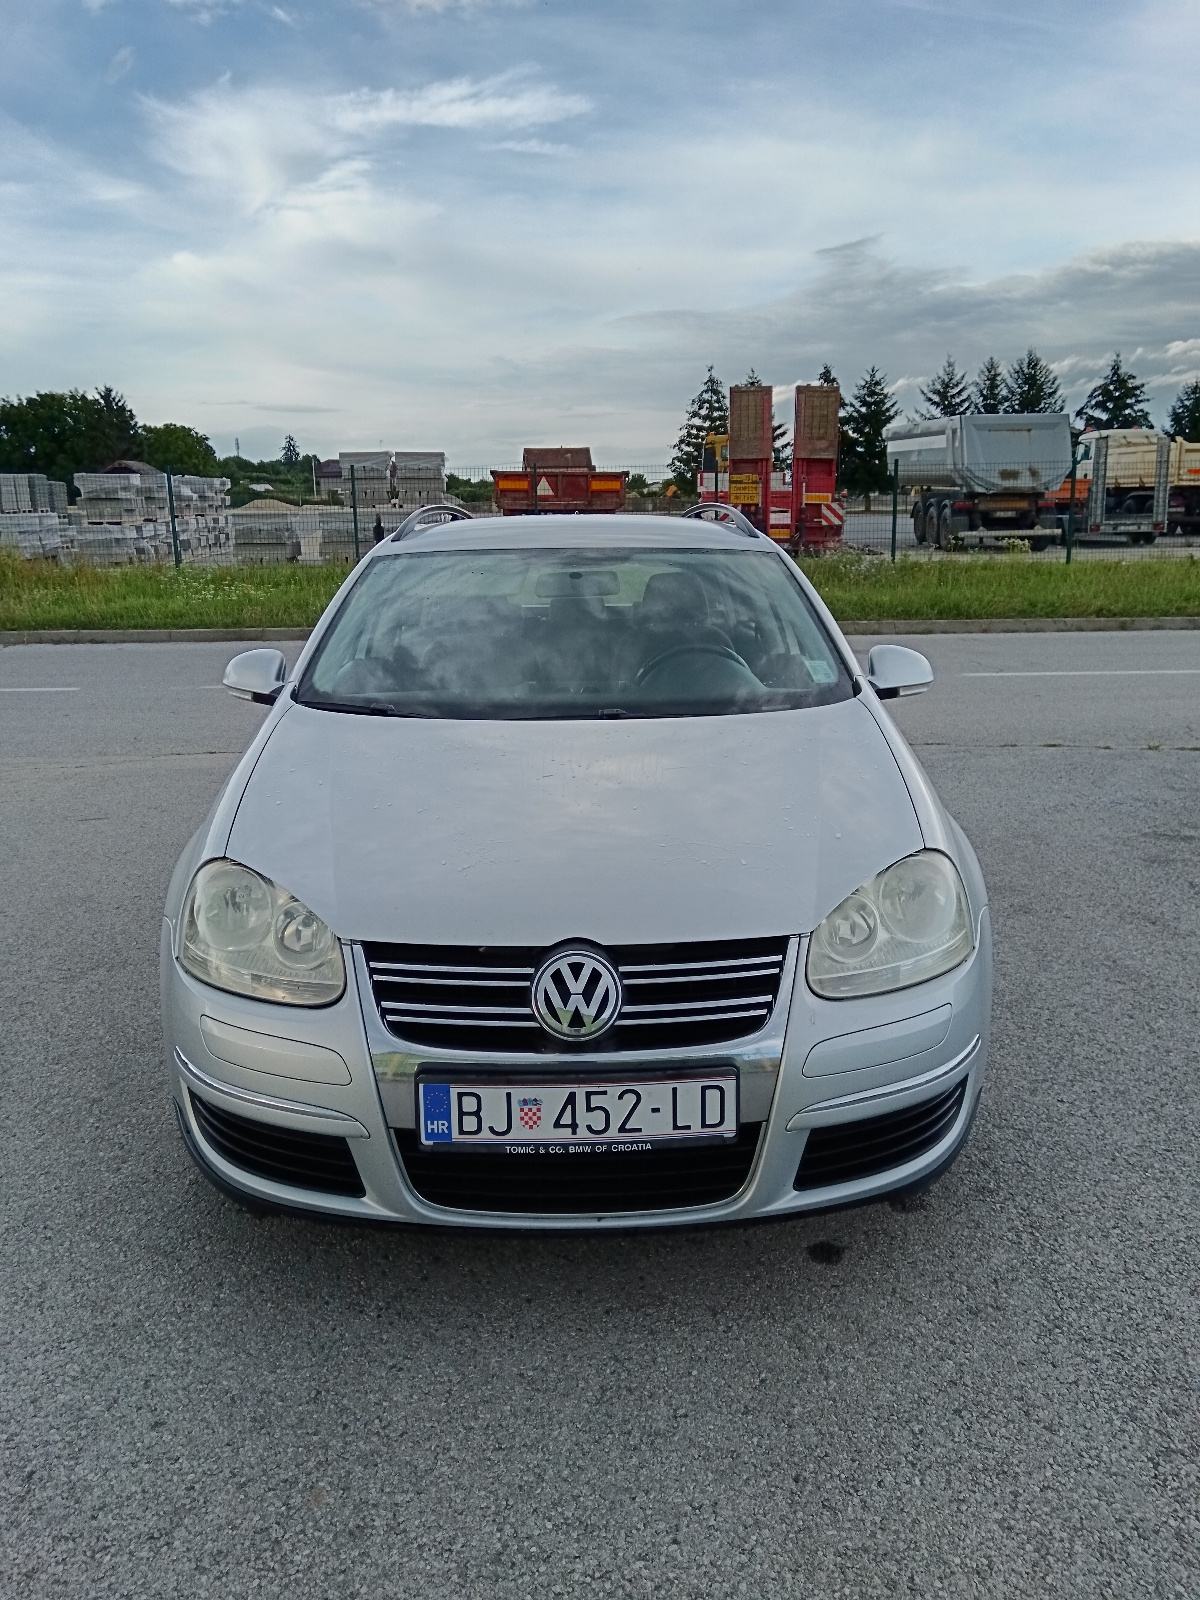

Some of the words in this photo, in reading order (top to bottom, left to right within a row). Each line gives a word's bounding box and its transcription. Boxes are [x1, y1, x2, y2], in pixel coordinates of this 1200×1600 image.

[537, 955, 617, 1036] VW
[427, 1120, 449, 1134] HR
[456, 1091, 513, 1137] BJ
[552, 1084, 726, 1136] 452-LD
[505, 1144, 536, 1154] TOMIĆ
[539, 1146, 546, 1154] &
[548, 1145, 565, 1154] CO.
[569, 1145, 592, 1153] BMW
[595, 1145, 608, 1153] OF
[611, 1143, 652, 1152] CROATIA
